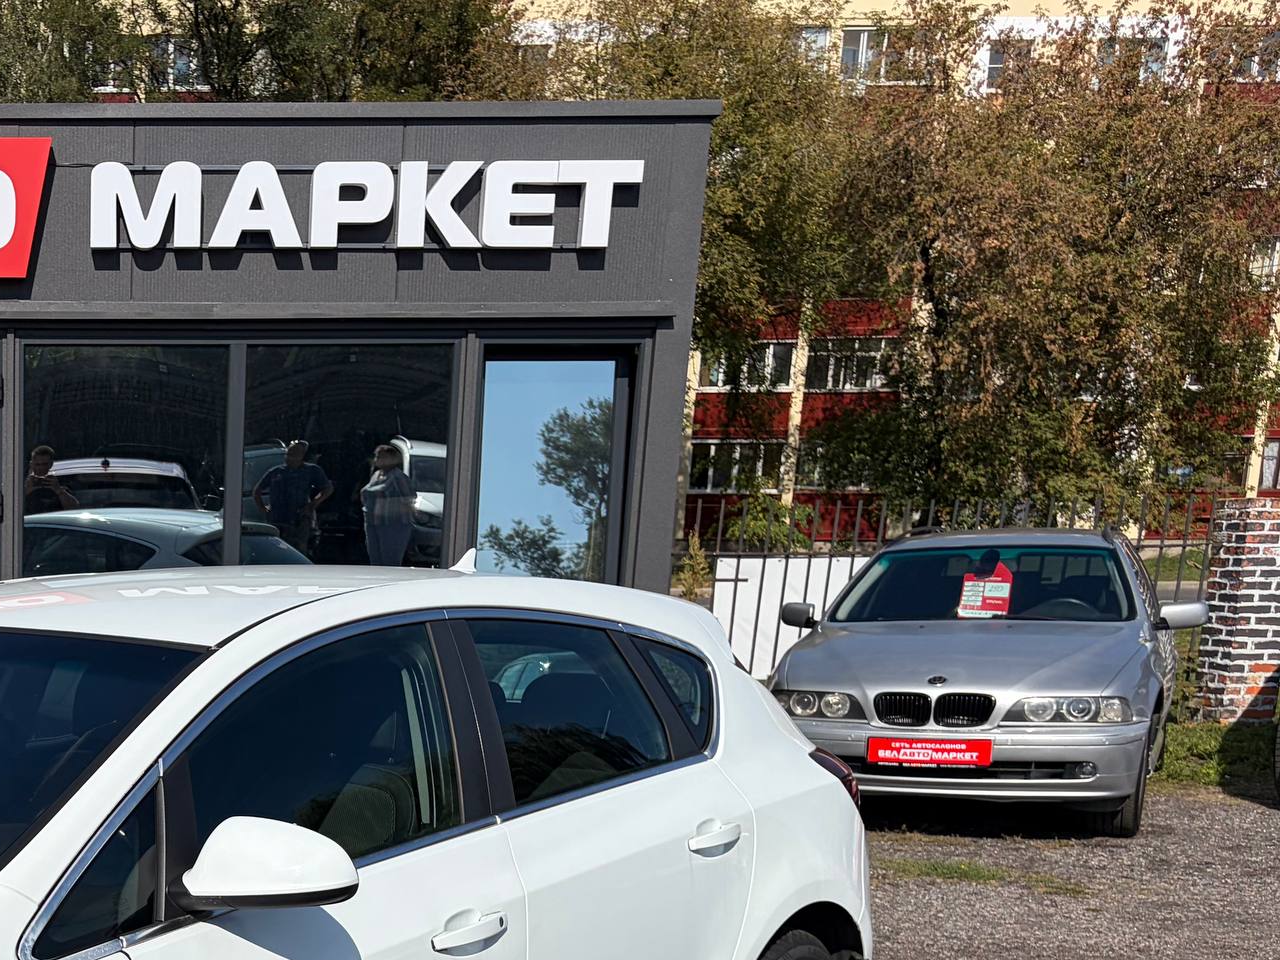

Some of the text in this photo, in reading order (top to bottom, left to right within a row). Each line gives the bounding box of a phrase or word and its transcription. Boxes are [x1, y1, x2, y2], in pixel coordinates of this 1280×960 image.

[90, 159, 645, 249] МАРКЕТ
[878, 749, 978, 760] БЕЛ АВТО МАРКЕТ
